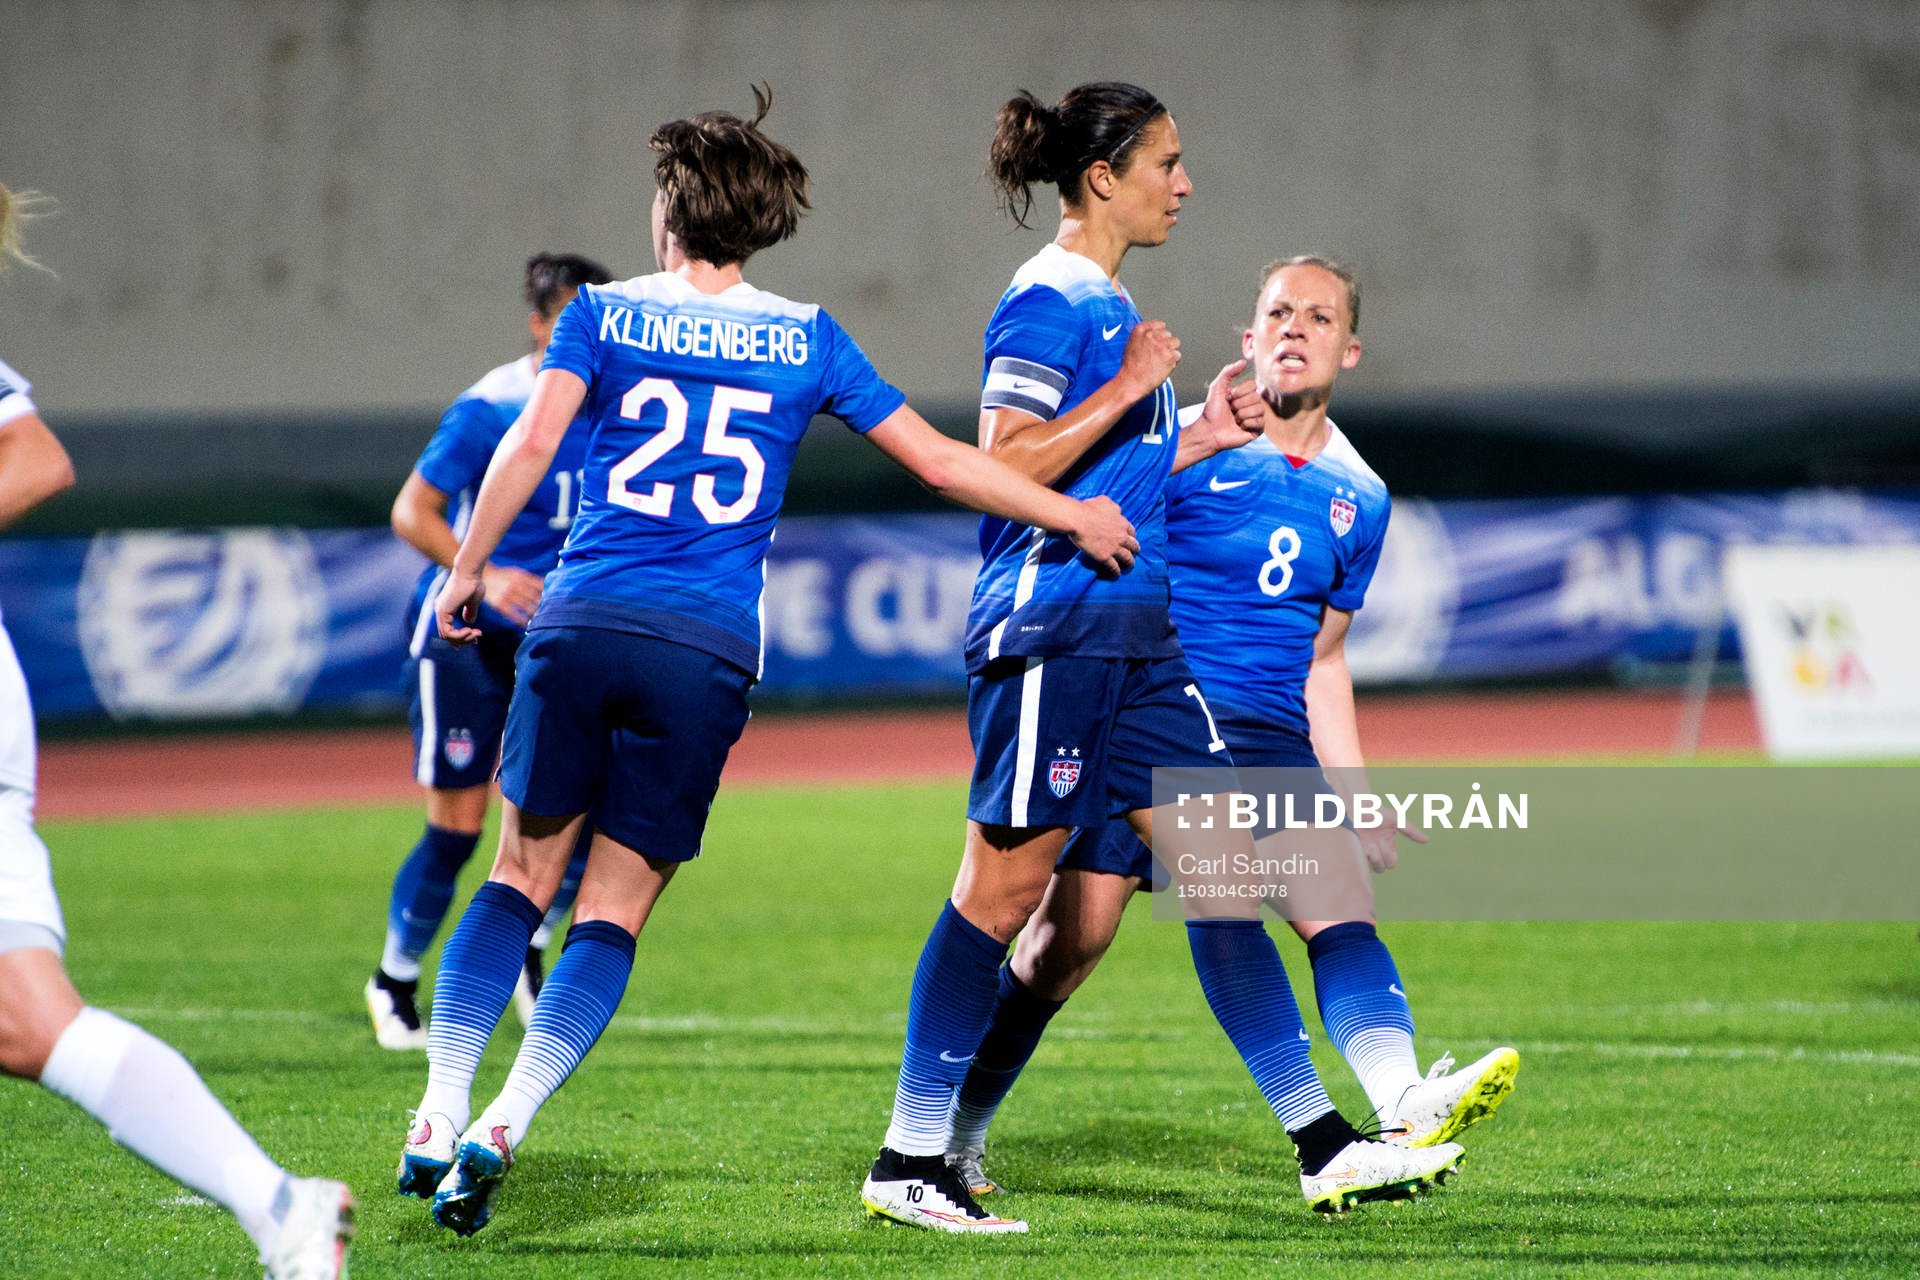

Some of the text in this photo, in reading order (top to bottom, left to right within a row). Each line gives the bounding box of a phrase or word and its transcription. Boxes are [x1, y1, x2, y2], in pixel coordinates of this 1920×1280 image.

[599, 305, 809, 366] KLINGENBERG
[606, 377, 773, 525] 25
[548, 468, 584, 529] 1
[1257, 525, 1302, 598] 8
[905, 1184, 924, 1204] 10
